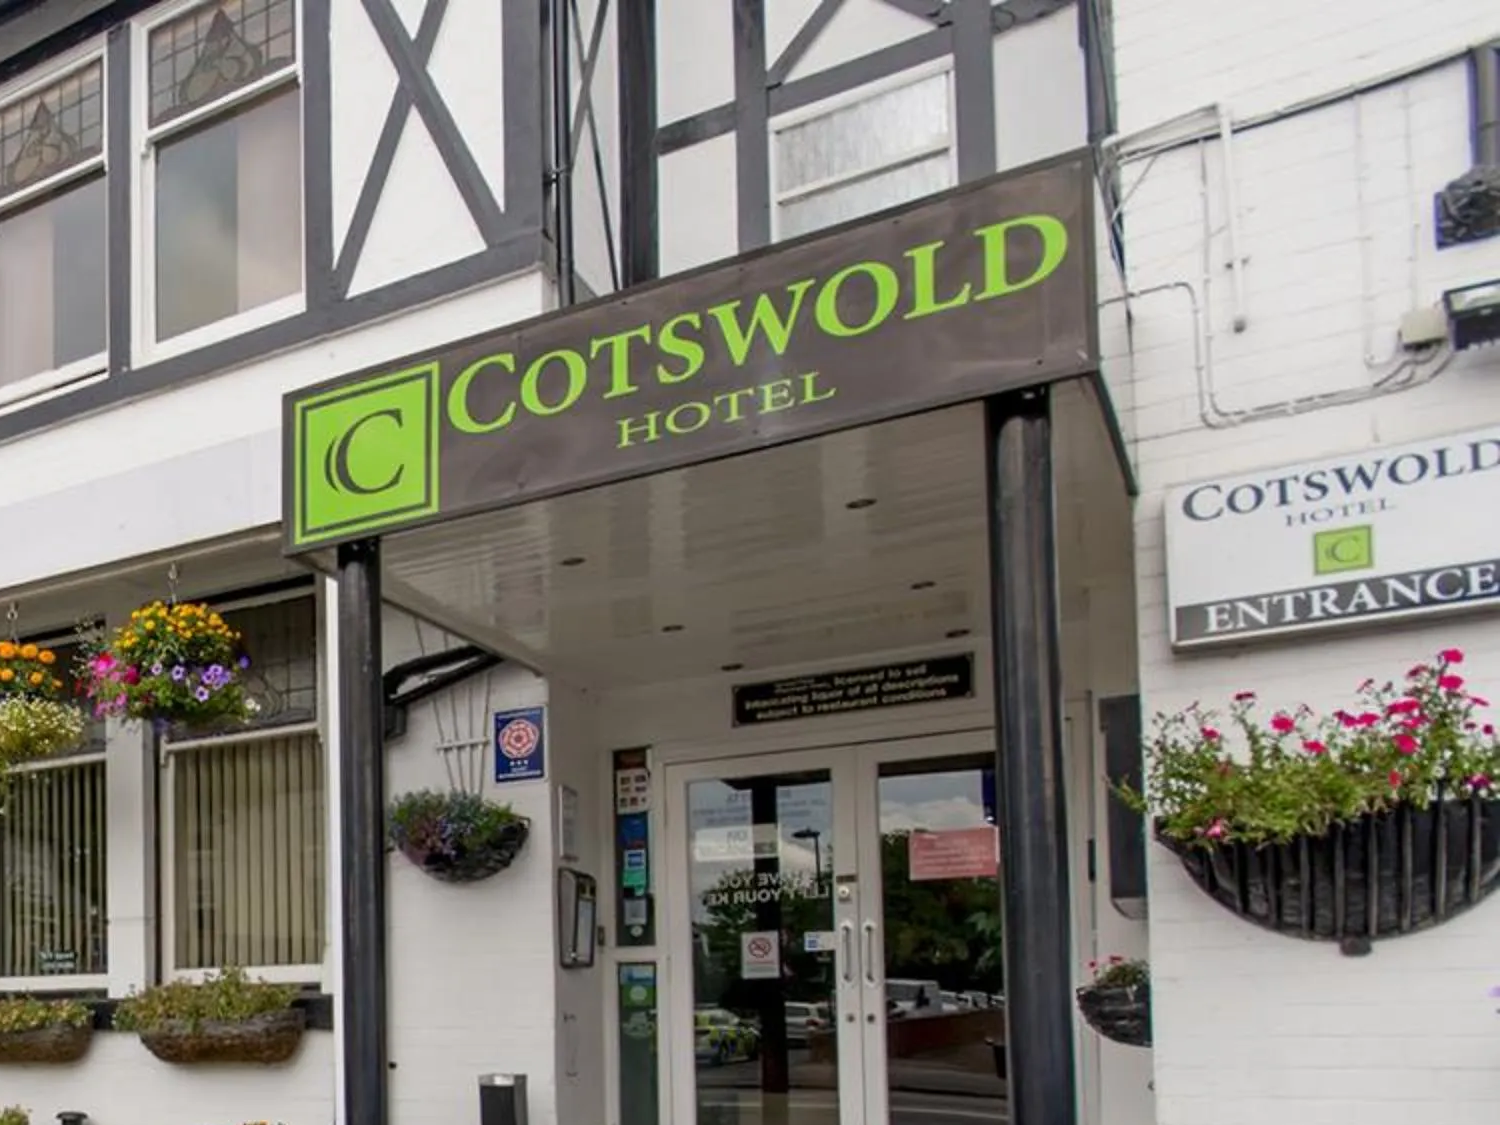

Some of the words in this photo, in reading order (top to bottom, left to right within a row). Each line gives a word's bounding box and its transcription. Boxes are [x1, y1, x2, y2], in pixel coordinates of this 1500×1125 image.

[446, 214, 1066, 435] COTSWOLD
[324, 407, 405, 495] C
[616, 372, 838, 449] HOTEL
[1181, 437, 1500, 522] COTSWOLD
[1285, 497, 1397, 527] HOTEL
[1203, 562, 1499, 633] ENTRANCE
